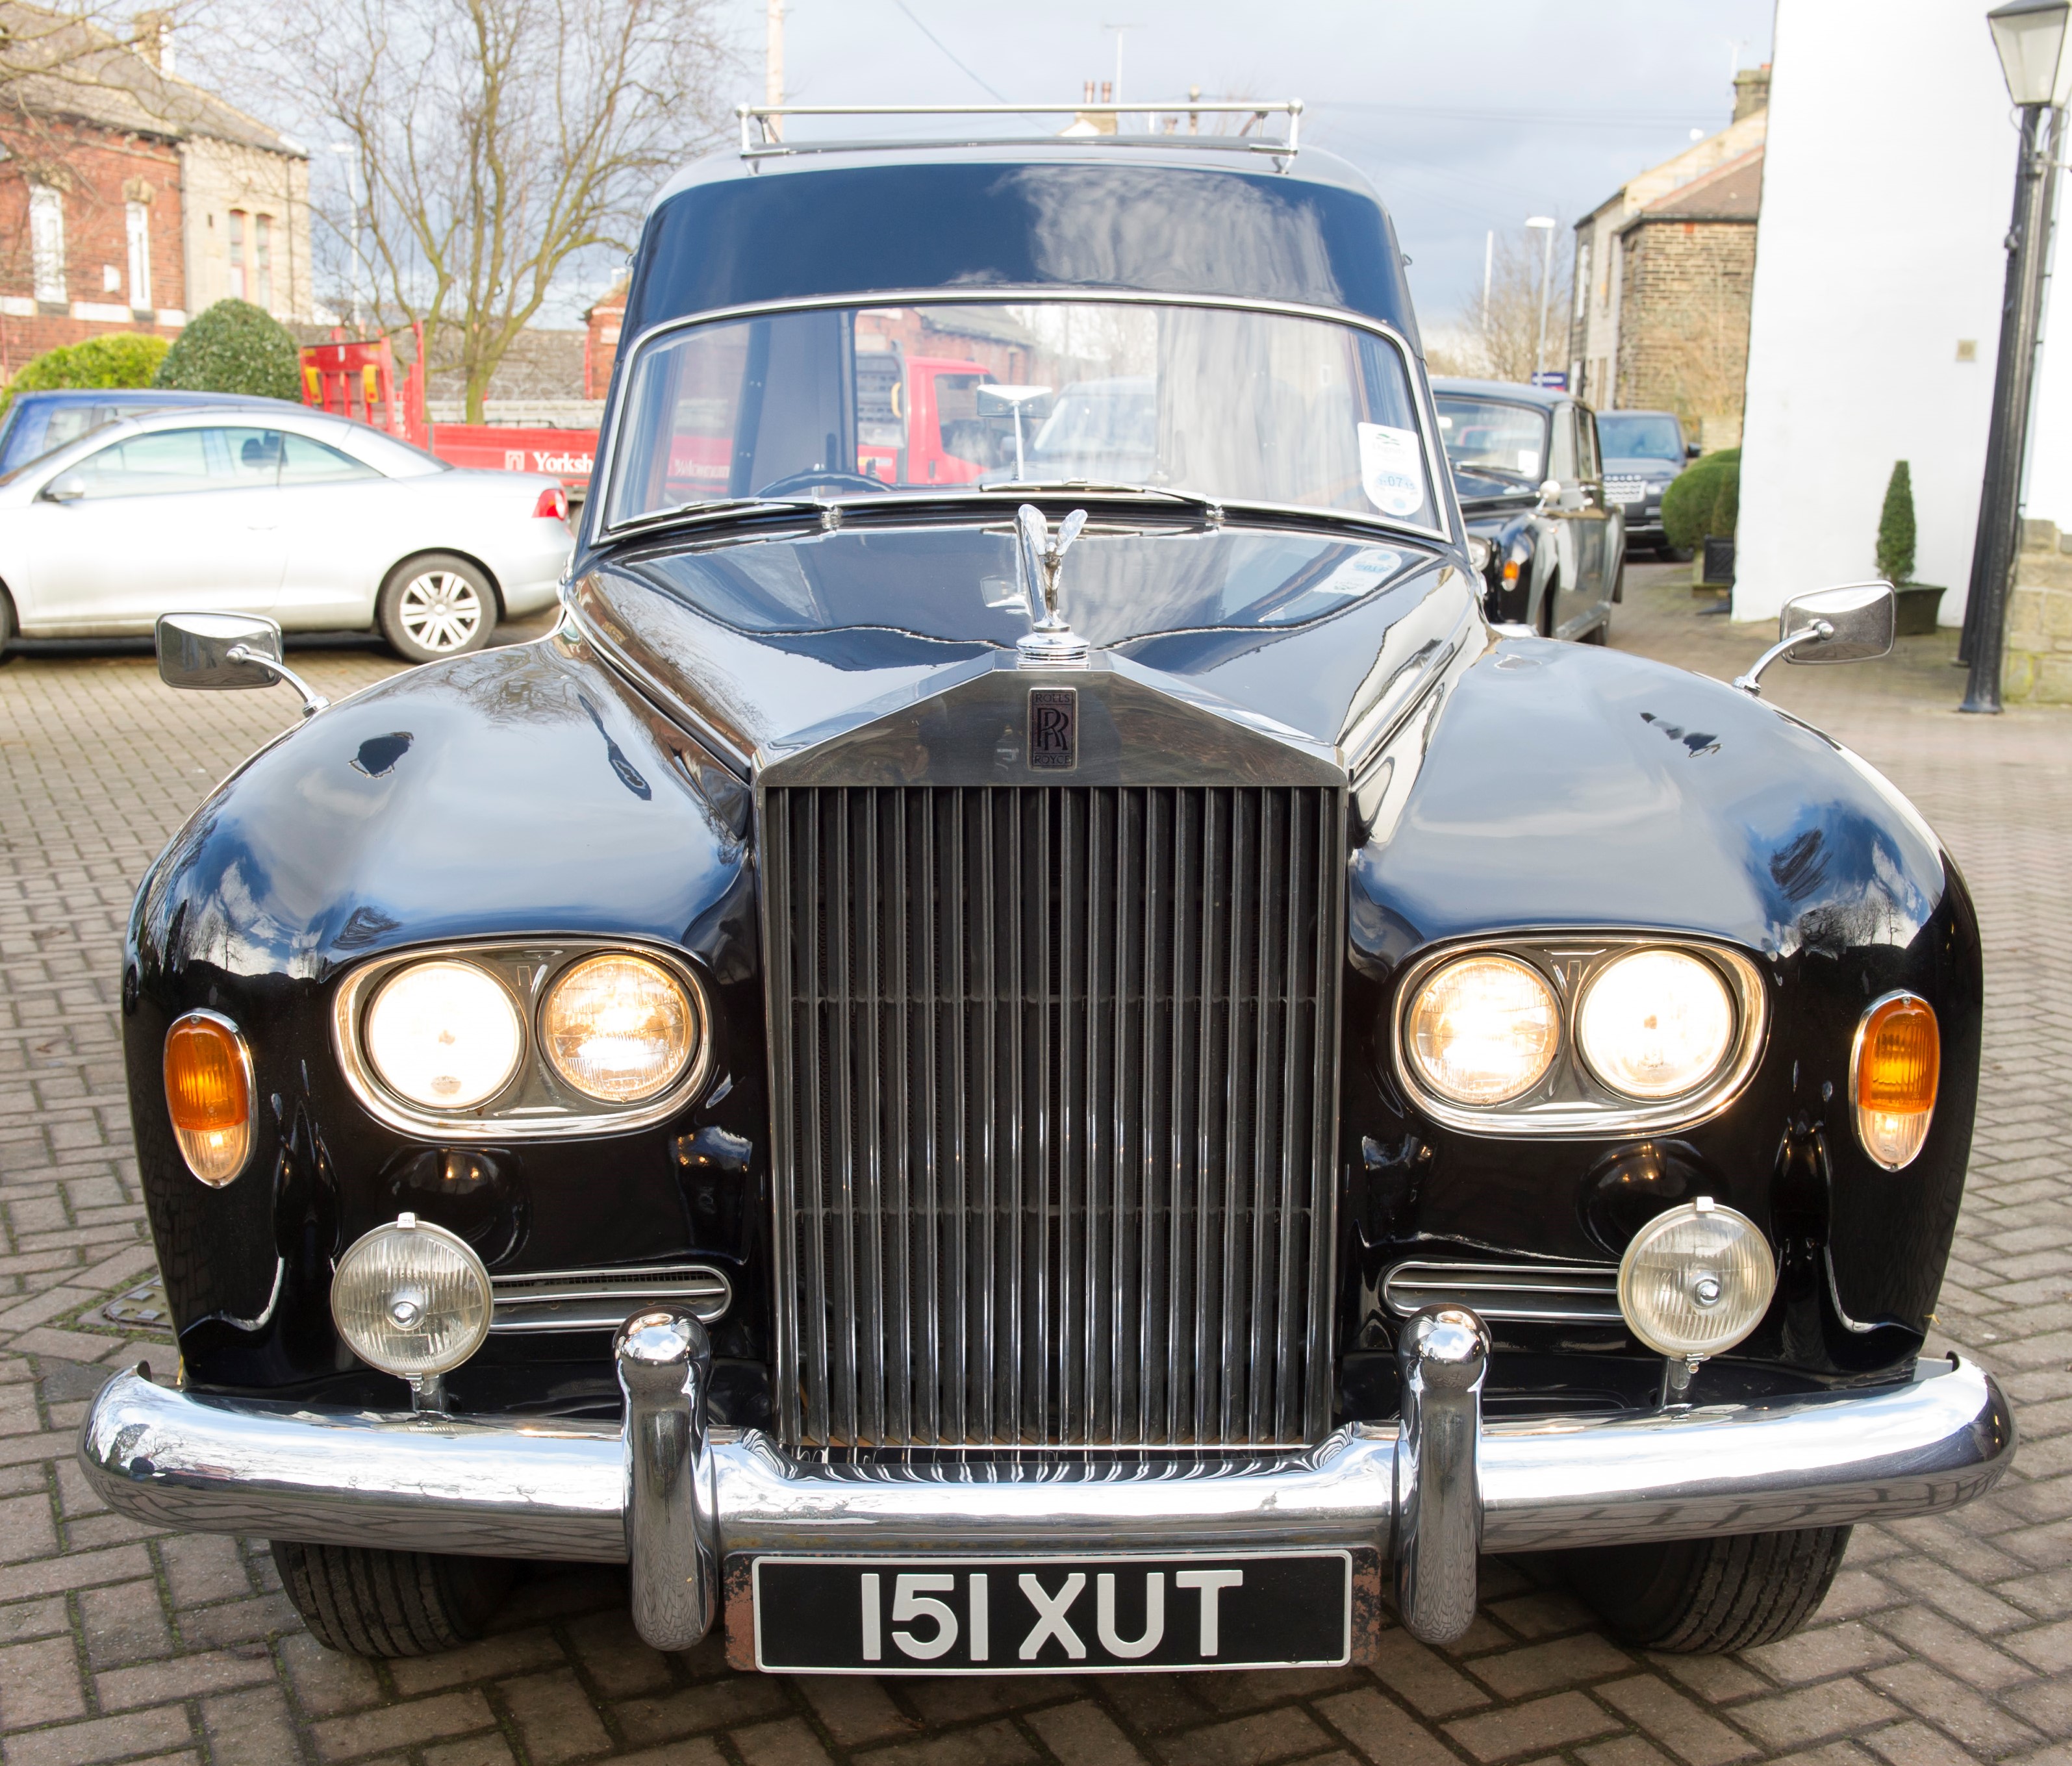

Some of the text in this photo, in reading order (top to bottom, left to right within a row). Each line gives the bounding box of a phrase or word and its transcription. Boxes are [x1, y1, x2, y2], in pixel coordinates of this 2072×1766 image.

[1387, 475, 1403, 488] 07
[1035, 693, 1070, 702] ROLLS
[1035, 755, 1070, 764] ROYCE
[861, 1569, 1243, 1661] 151 XUT
